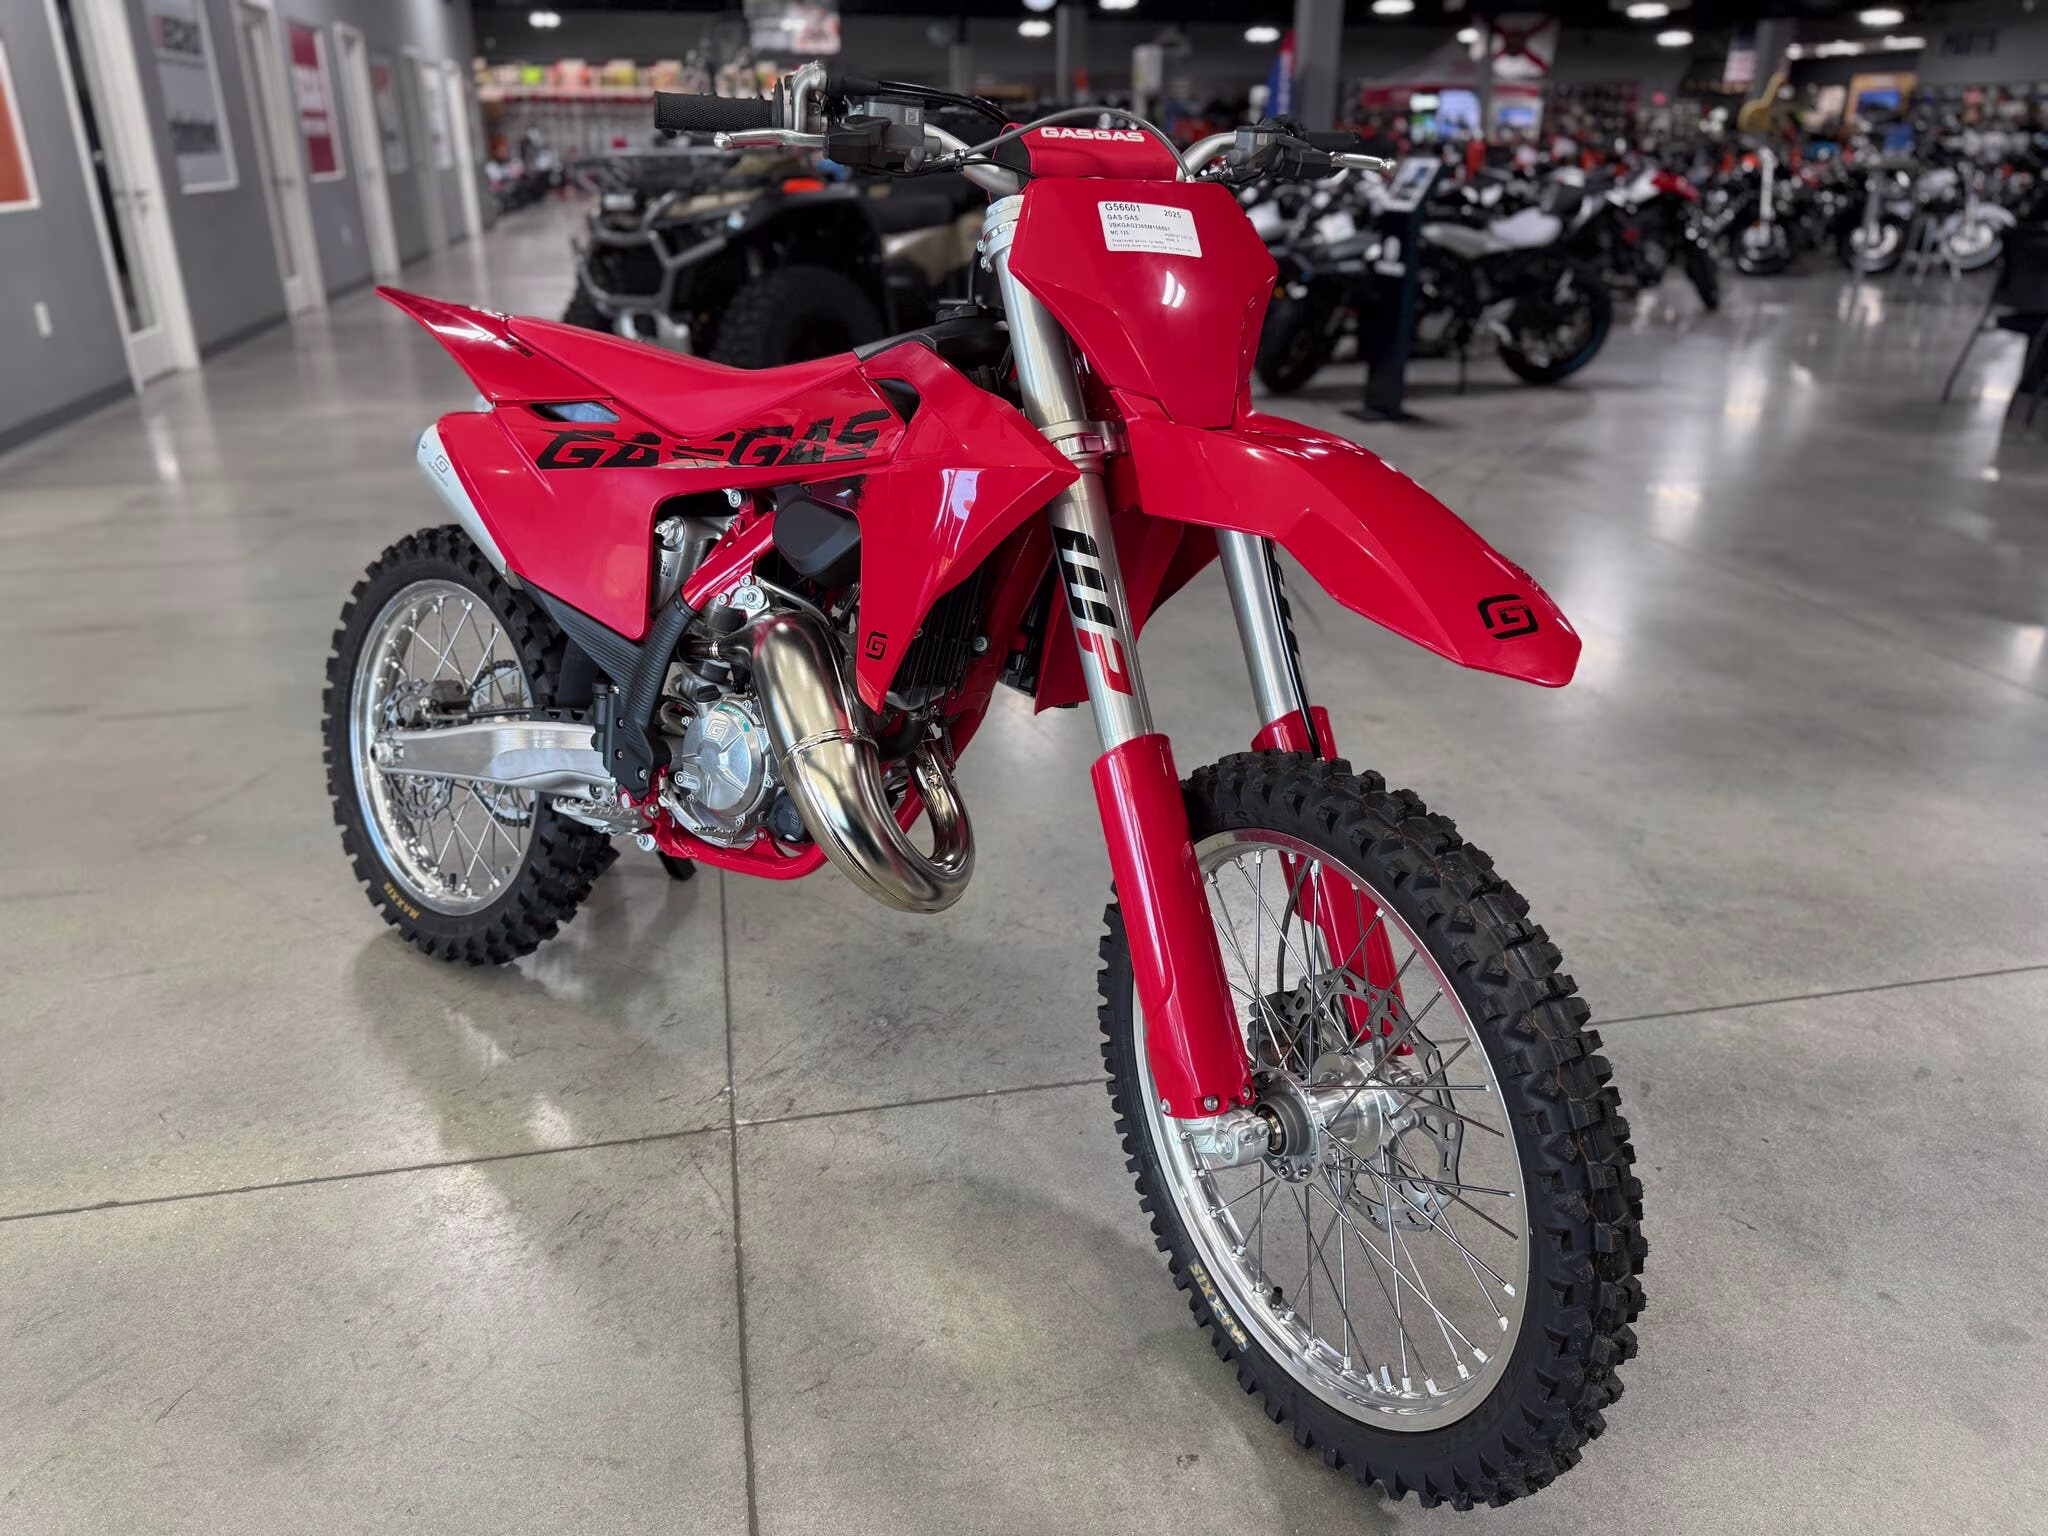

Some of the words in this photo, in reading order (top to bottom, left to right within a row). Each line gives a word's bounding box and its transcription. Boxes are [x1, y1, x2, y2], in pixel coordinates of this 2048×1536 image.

[1040, 127, 1145, 142] GASGAS
[1105, 203, 1141, 212] G56601
[1164, 210, 1182, 219] 2025
